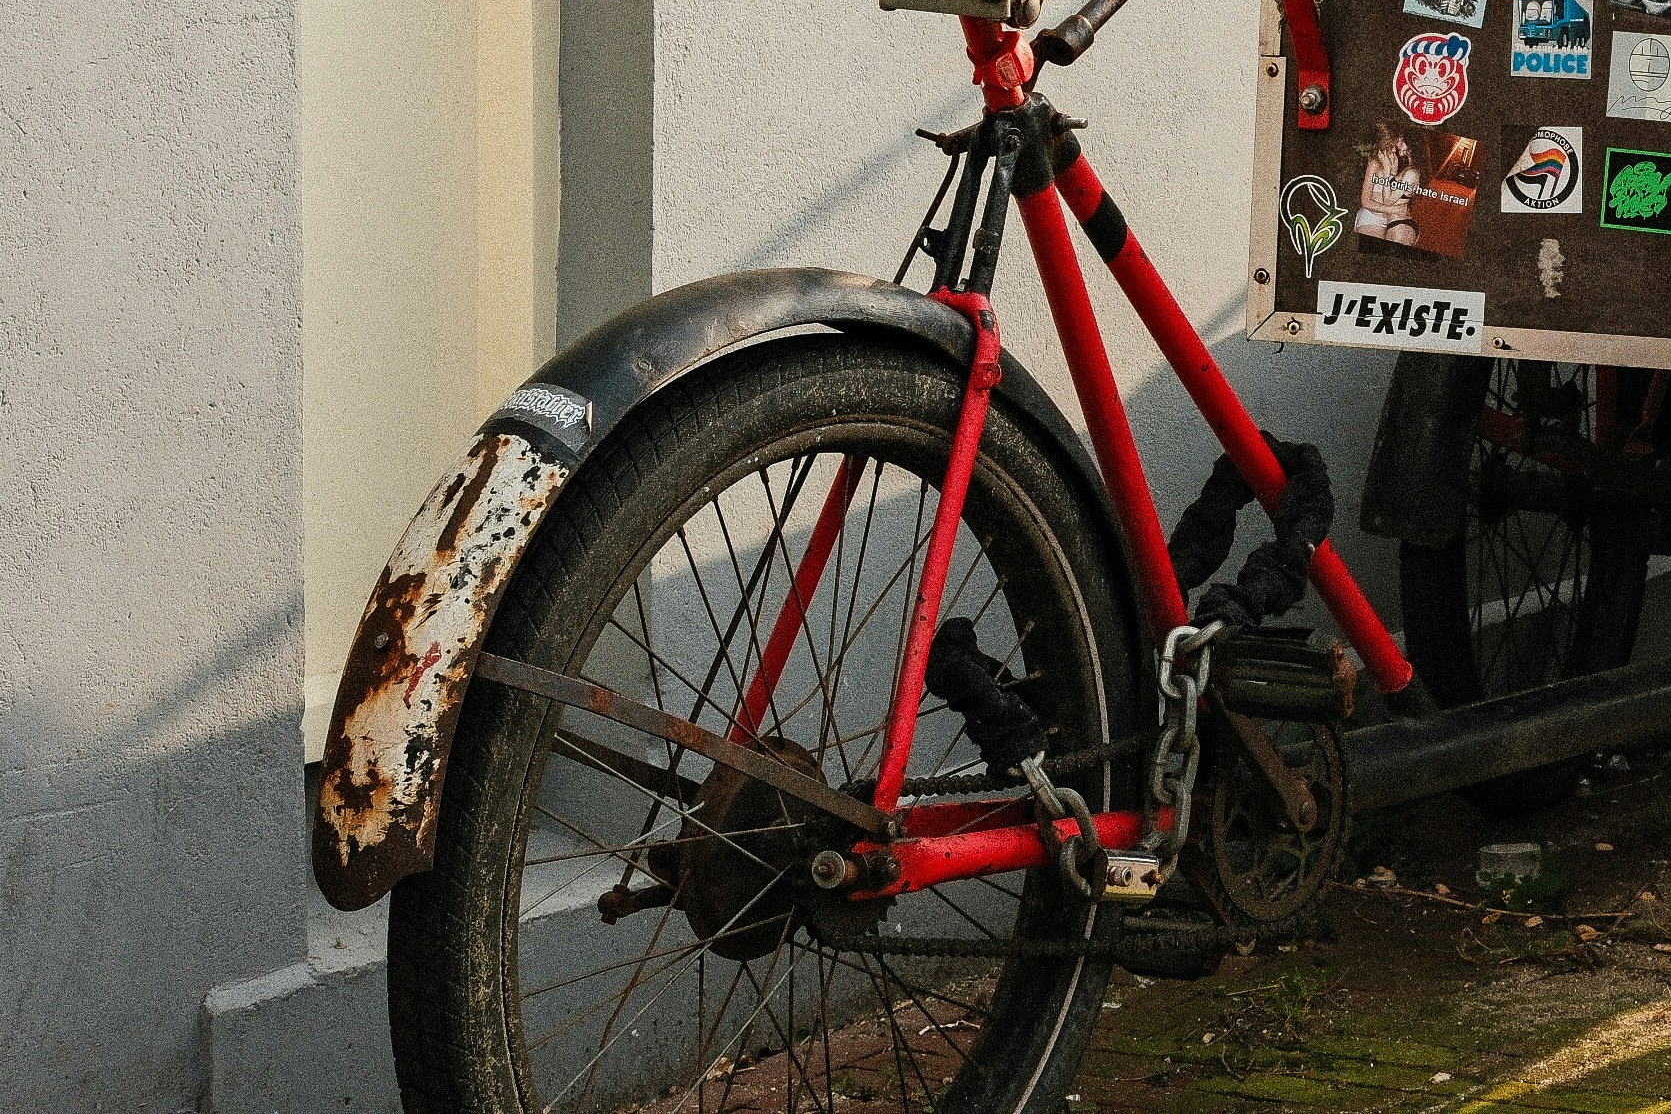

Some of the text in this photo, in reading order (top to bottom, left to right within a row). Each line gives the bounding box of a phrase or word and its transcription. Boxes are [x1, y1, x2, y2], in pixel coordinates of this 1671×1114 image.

[1532, 43, 1558, 53] sound
[1513, 52, 1588, 74] POLICE
[1422, 100, 1435, 115] 福
[1372, 173, 1469, 207] hot girls hate Israel
[1524, 197, 1560, 209] AKTION
[1322, 293, 1476, 341] J'EXISTE.
